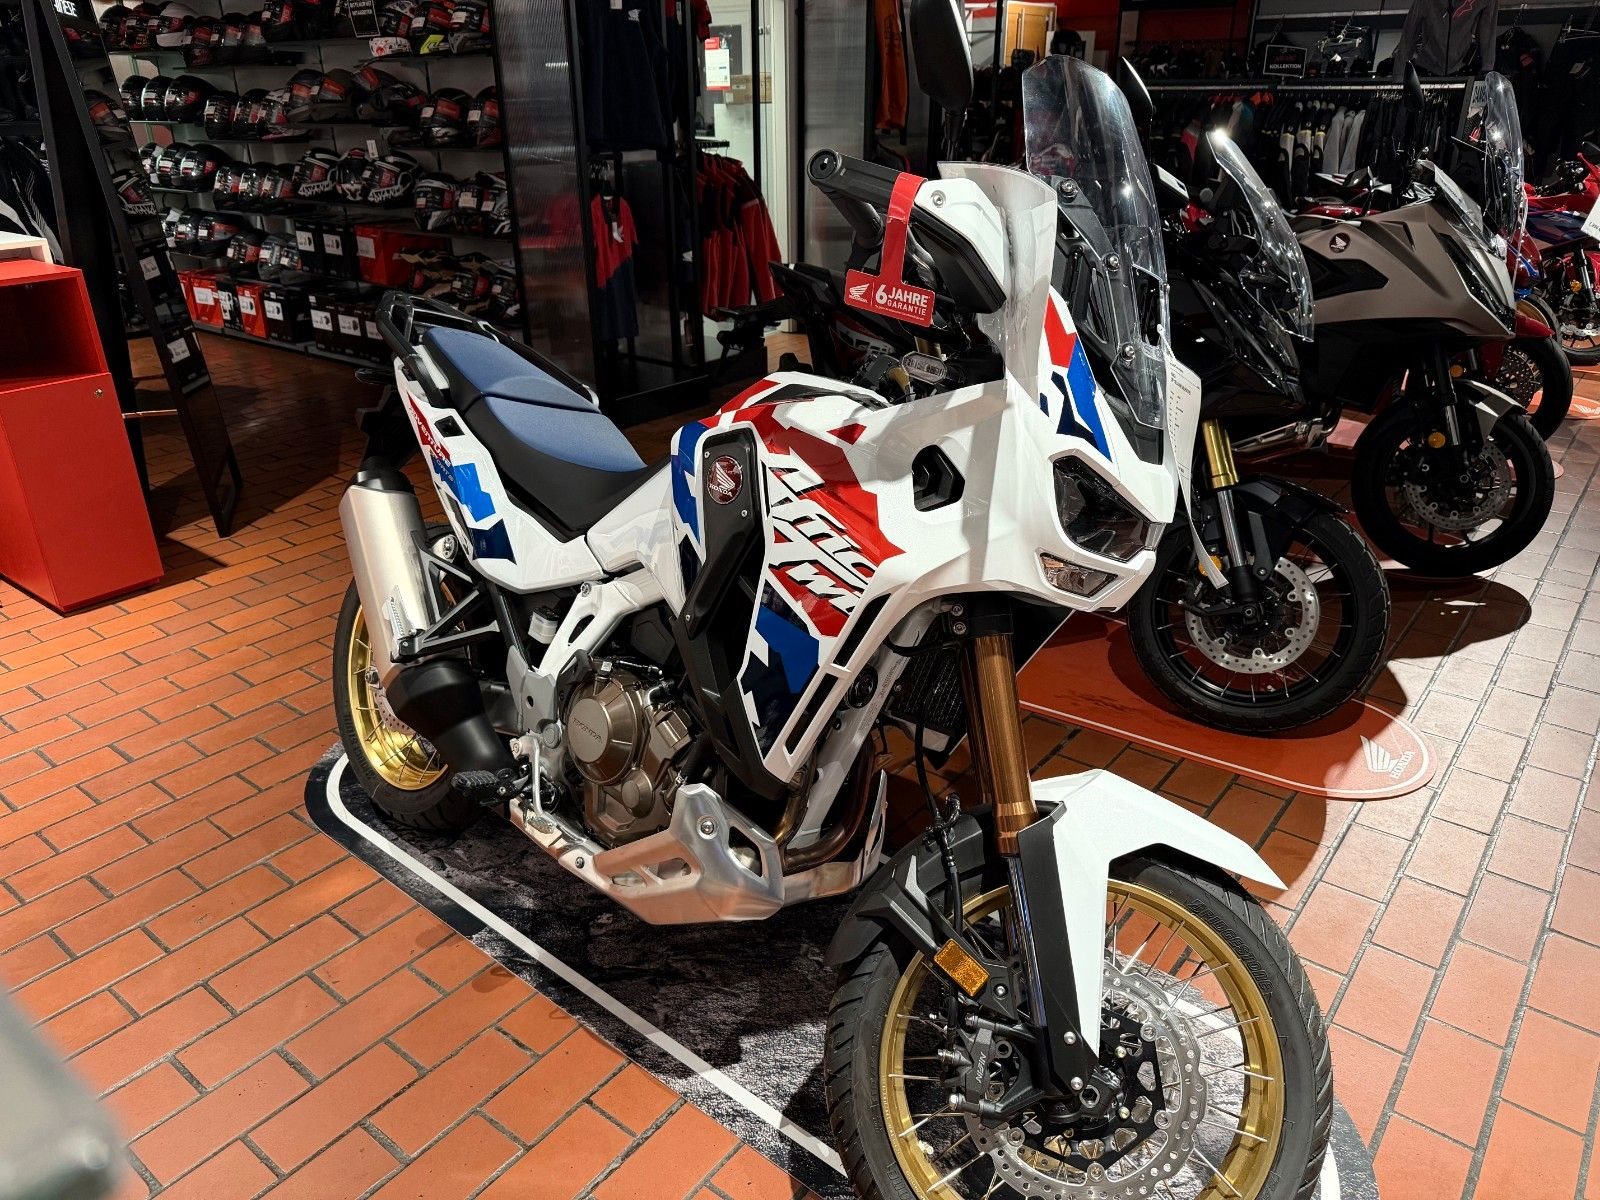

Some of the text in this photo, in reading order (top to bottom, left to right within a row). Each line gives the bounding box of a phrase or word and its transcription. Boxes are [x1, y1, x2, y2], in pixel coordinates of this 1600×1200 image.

[875, 284, 889, 305] 6
[887, 300, 927, 316] GARANTIE
[709, 483, 733, 497] HONDA
